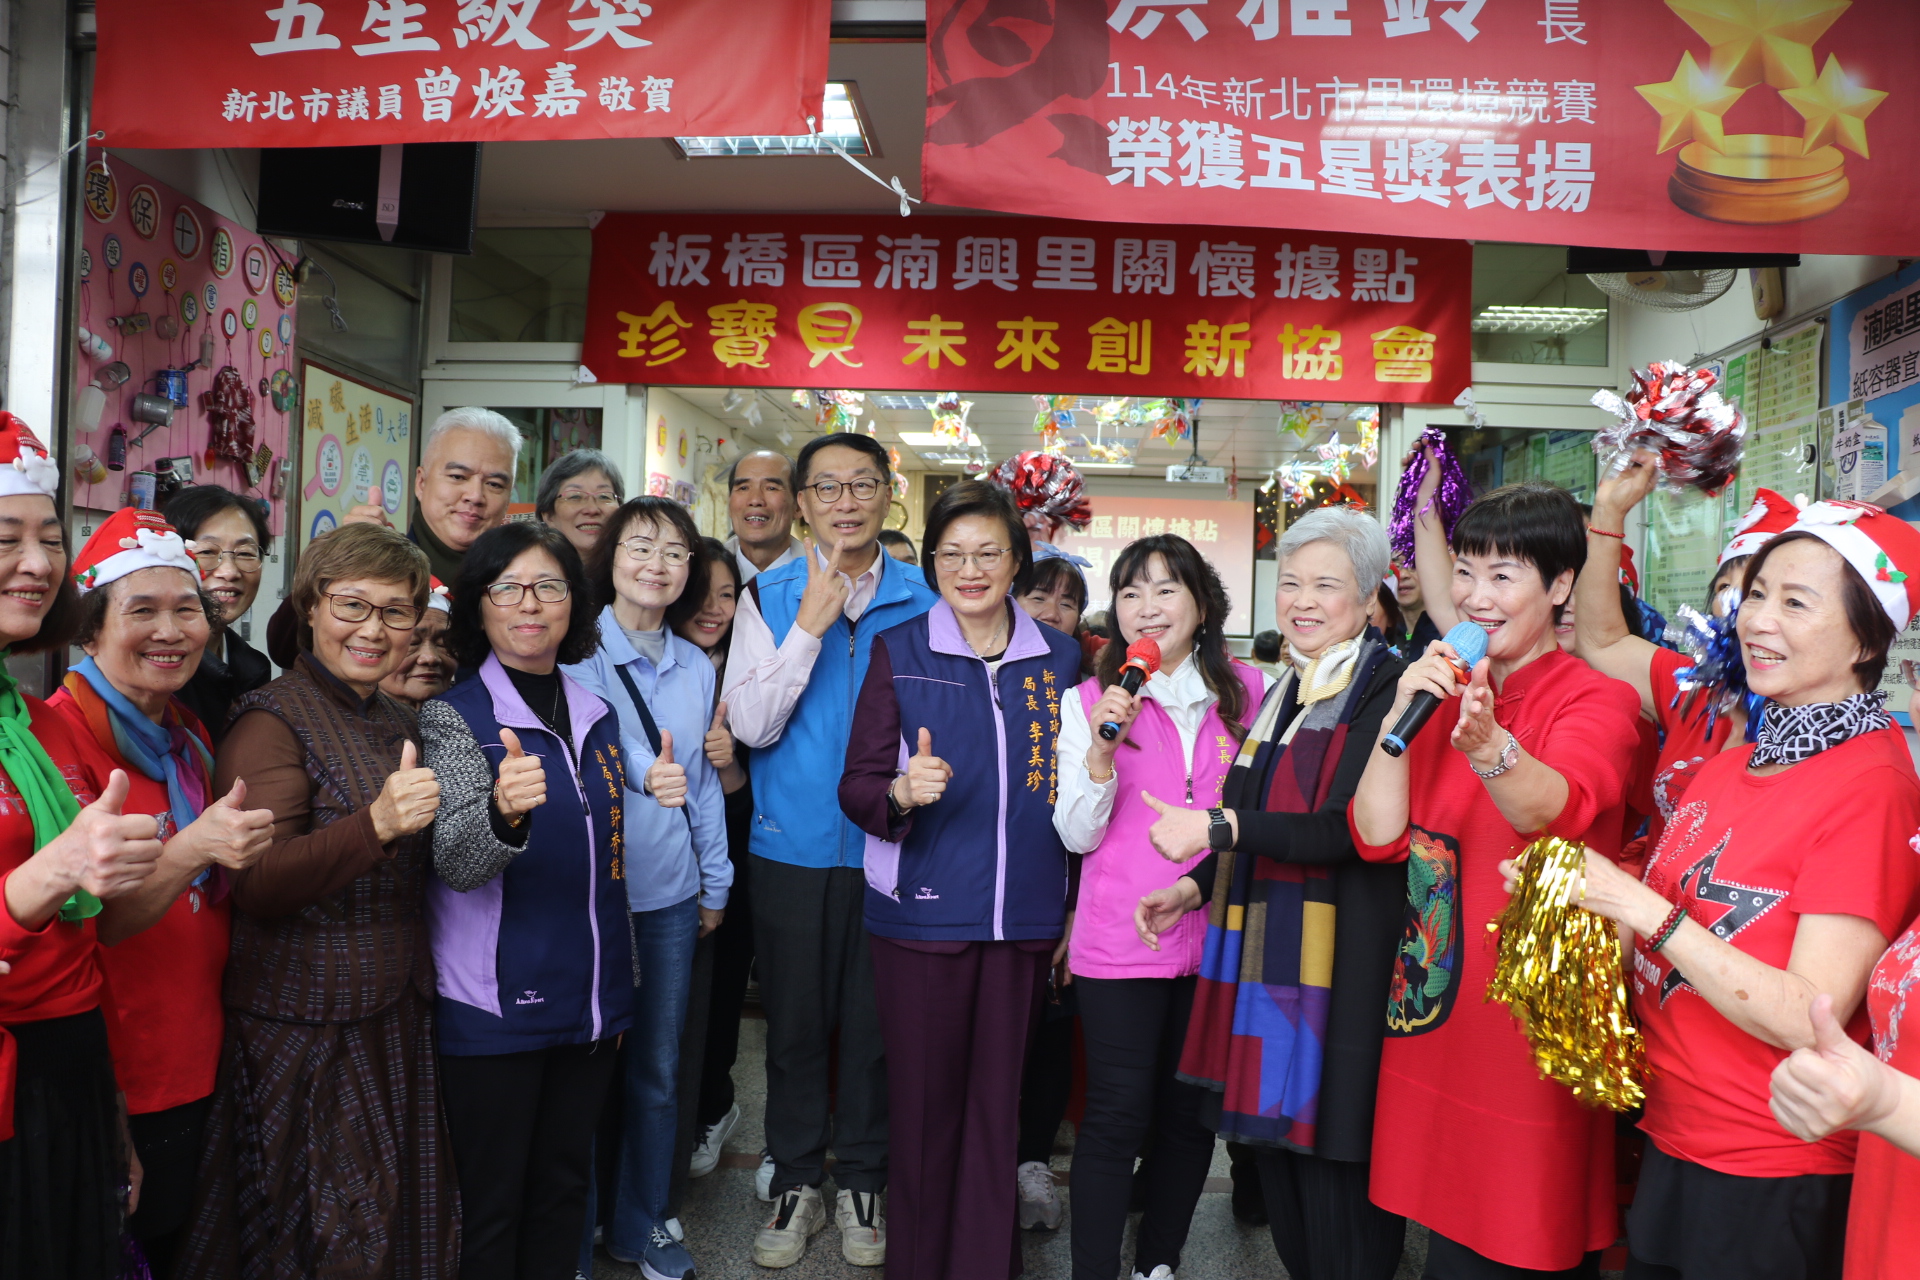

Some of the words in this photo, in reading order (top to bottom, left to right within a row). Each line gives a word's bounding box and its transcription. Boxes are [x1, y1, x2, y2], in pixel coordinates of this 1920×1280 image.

[1106, 62, 1598, 125] 114年新北市里環境競賽
[1106, 116, 1595, 212] 榮獲五星獎表揚
[649, 232, 1418, 303] 板橋區湳興里關懷據點
[616, 300, 1437, 383] 珍寶貝未來創新協會
[1022, 676, 1040, 711] 局長
[1026, 720, 1045, 792] 李美珍
[1215, 735, 1233, 764] 里長
